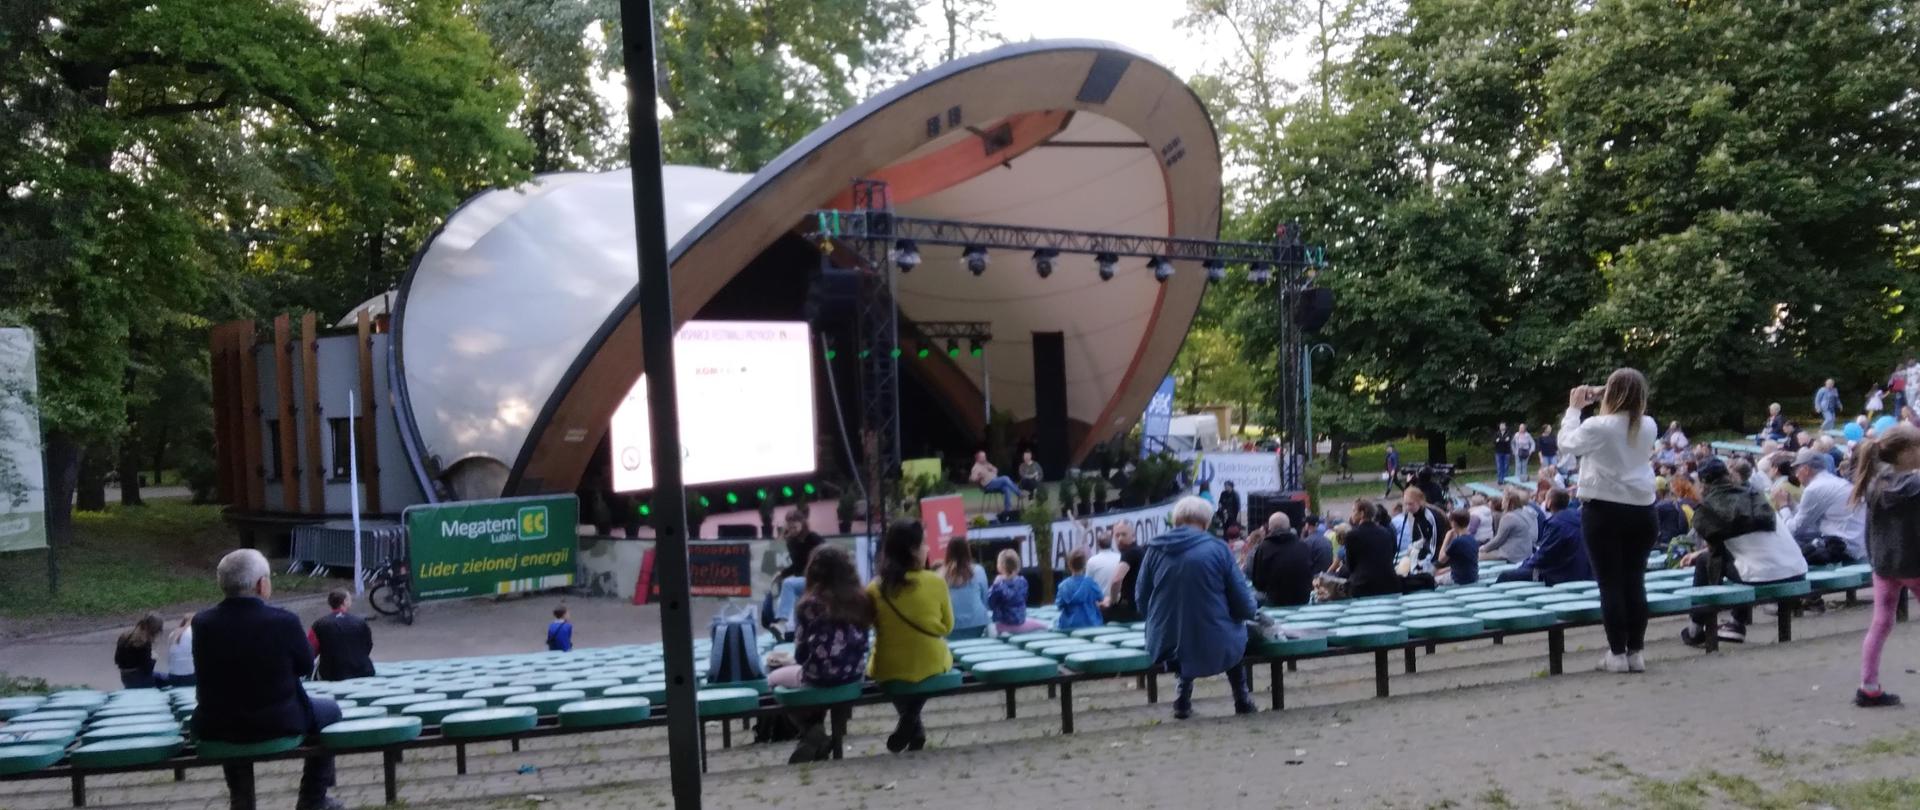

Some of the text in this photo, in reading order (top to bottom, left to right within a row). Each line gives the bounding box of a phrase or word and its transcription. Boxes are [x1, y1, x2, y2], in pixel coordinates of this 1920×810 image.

[441, 518, 517, 539] Megatem
[491, 532, 517, 544] Lublin
[420, 548, 569, 579] Lider zielonej energii
